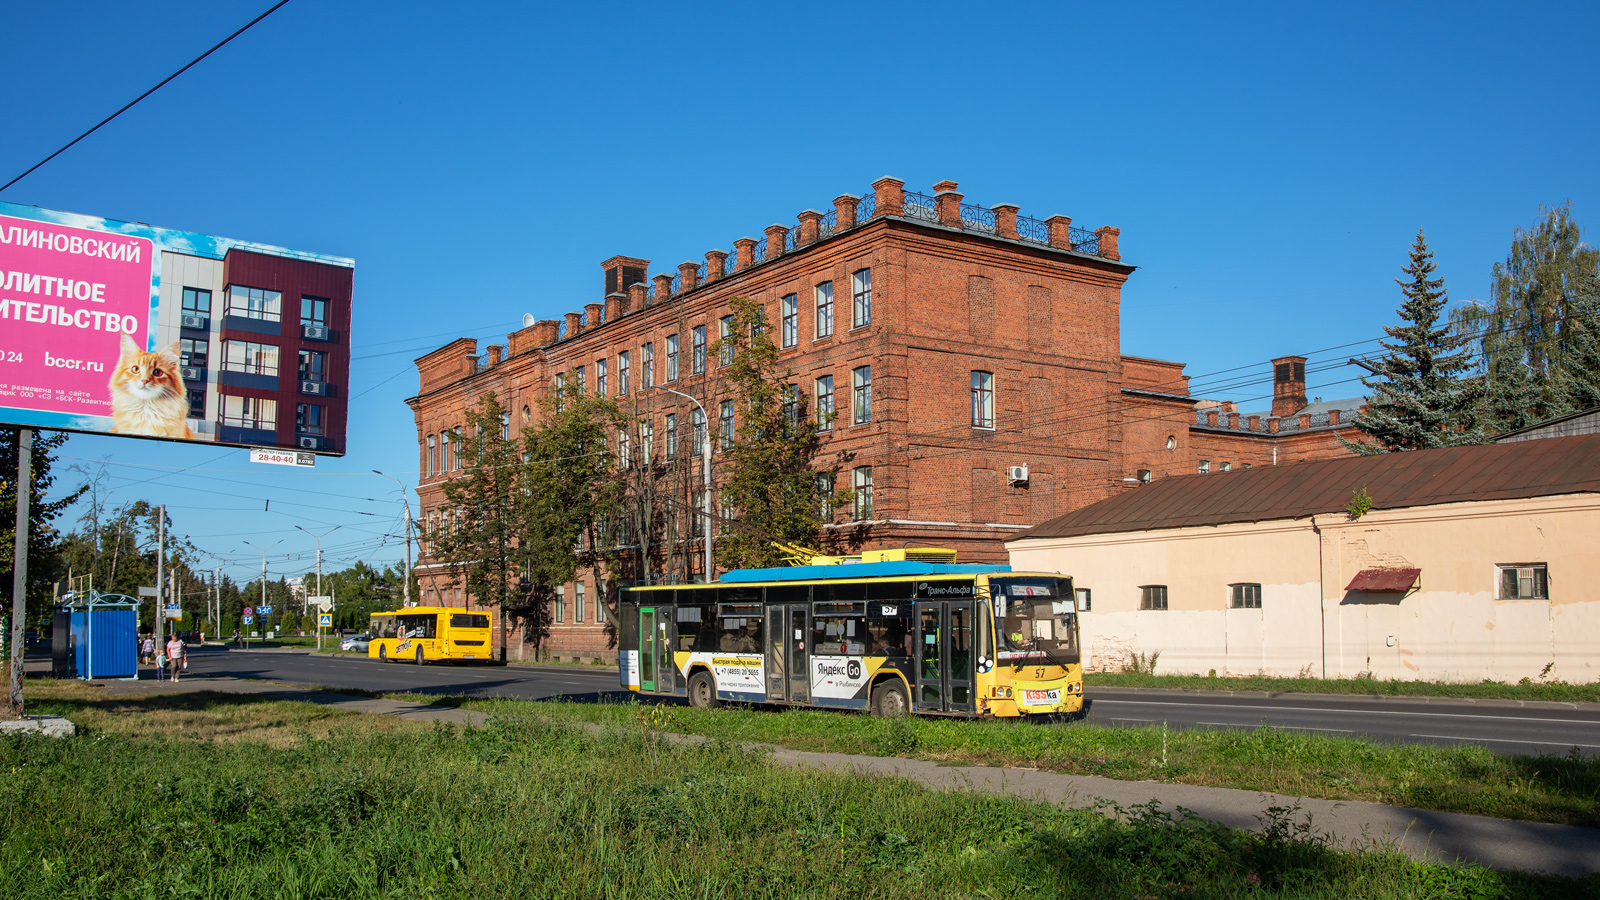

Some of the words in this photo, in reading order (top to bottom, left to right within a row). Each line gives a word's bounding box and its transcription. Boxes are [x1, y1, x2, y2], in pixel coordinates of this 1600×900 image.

[7, 351, 23, 363] 24
[44, 351, 104, 372] bccr.ru
[11, 384, 52, 394] размещена
[68, 390, 91, 398] сайте
[258, 454, 294, 463] 28-40-40
[927, 585, 971, 596] Транс-Альфа
[817, 662, 846, 677] Яндекс
[848, 663, 860, 676] Go
[1035, 668, 1046, 679] 57
